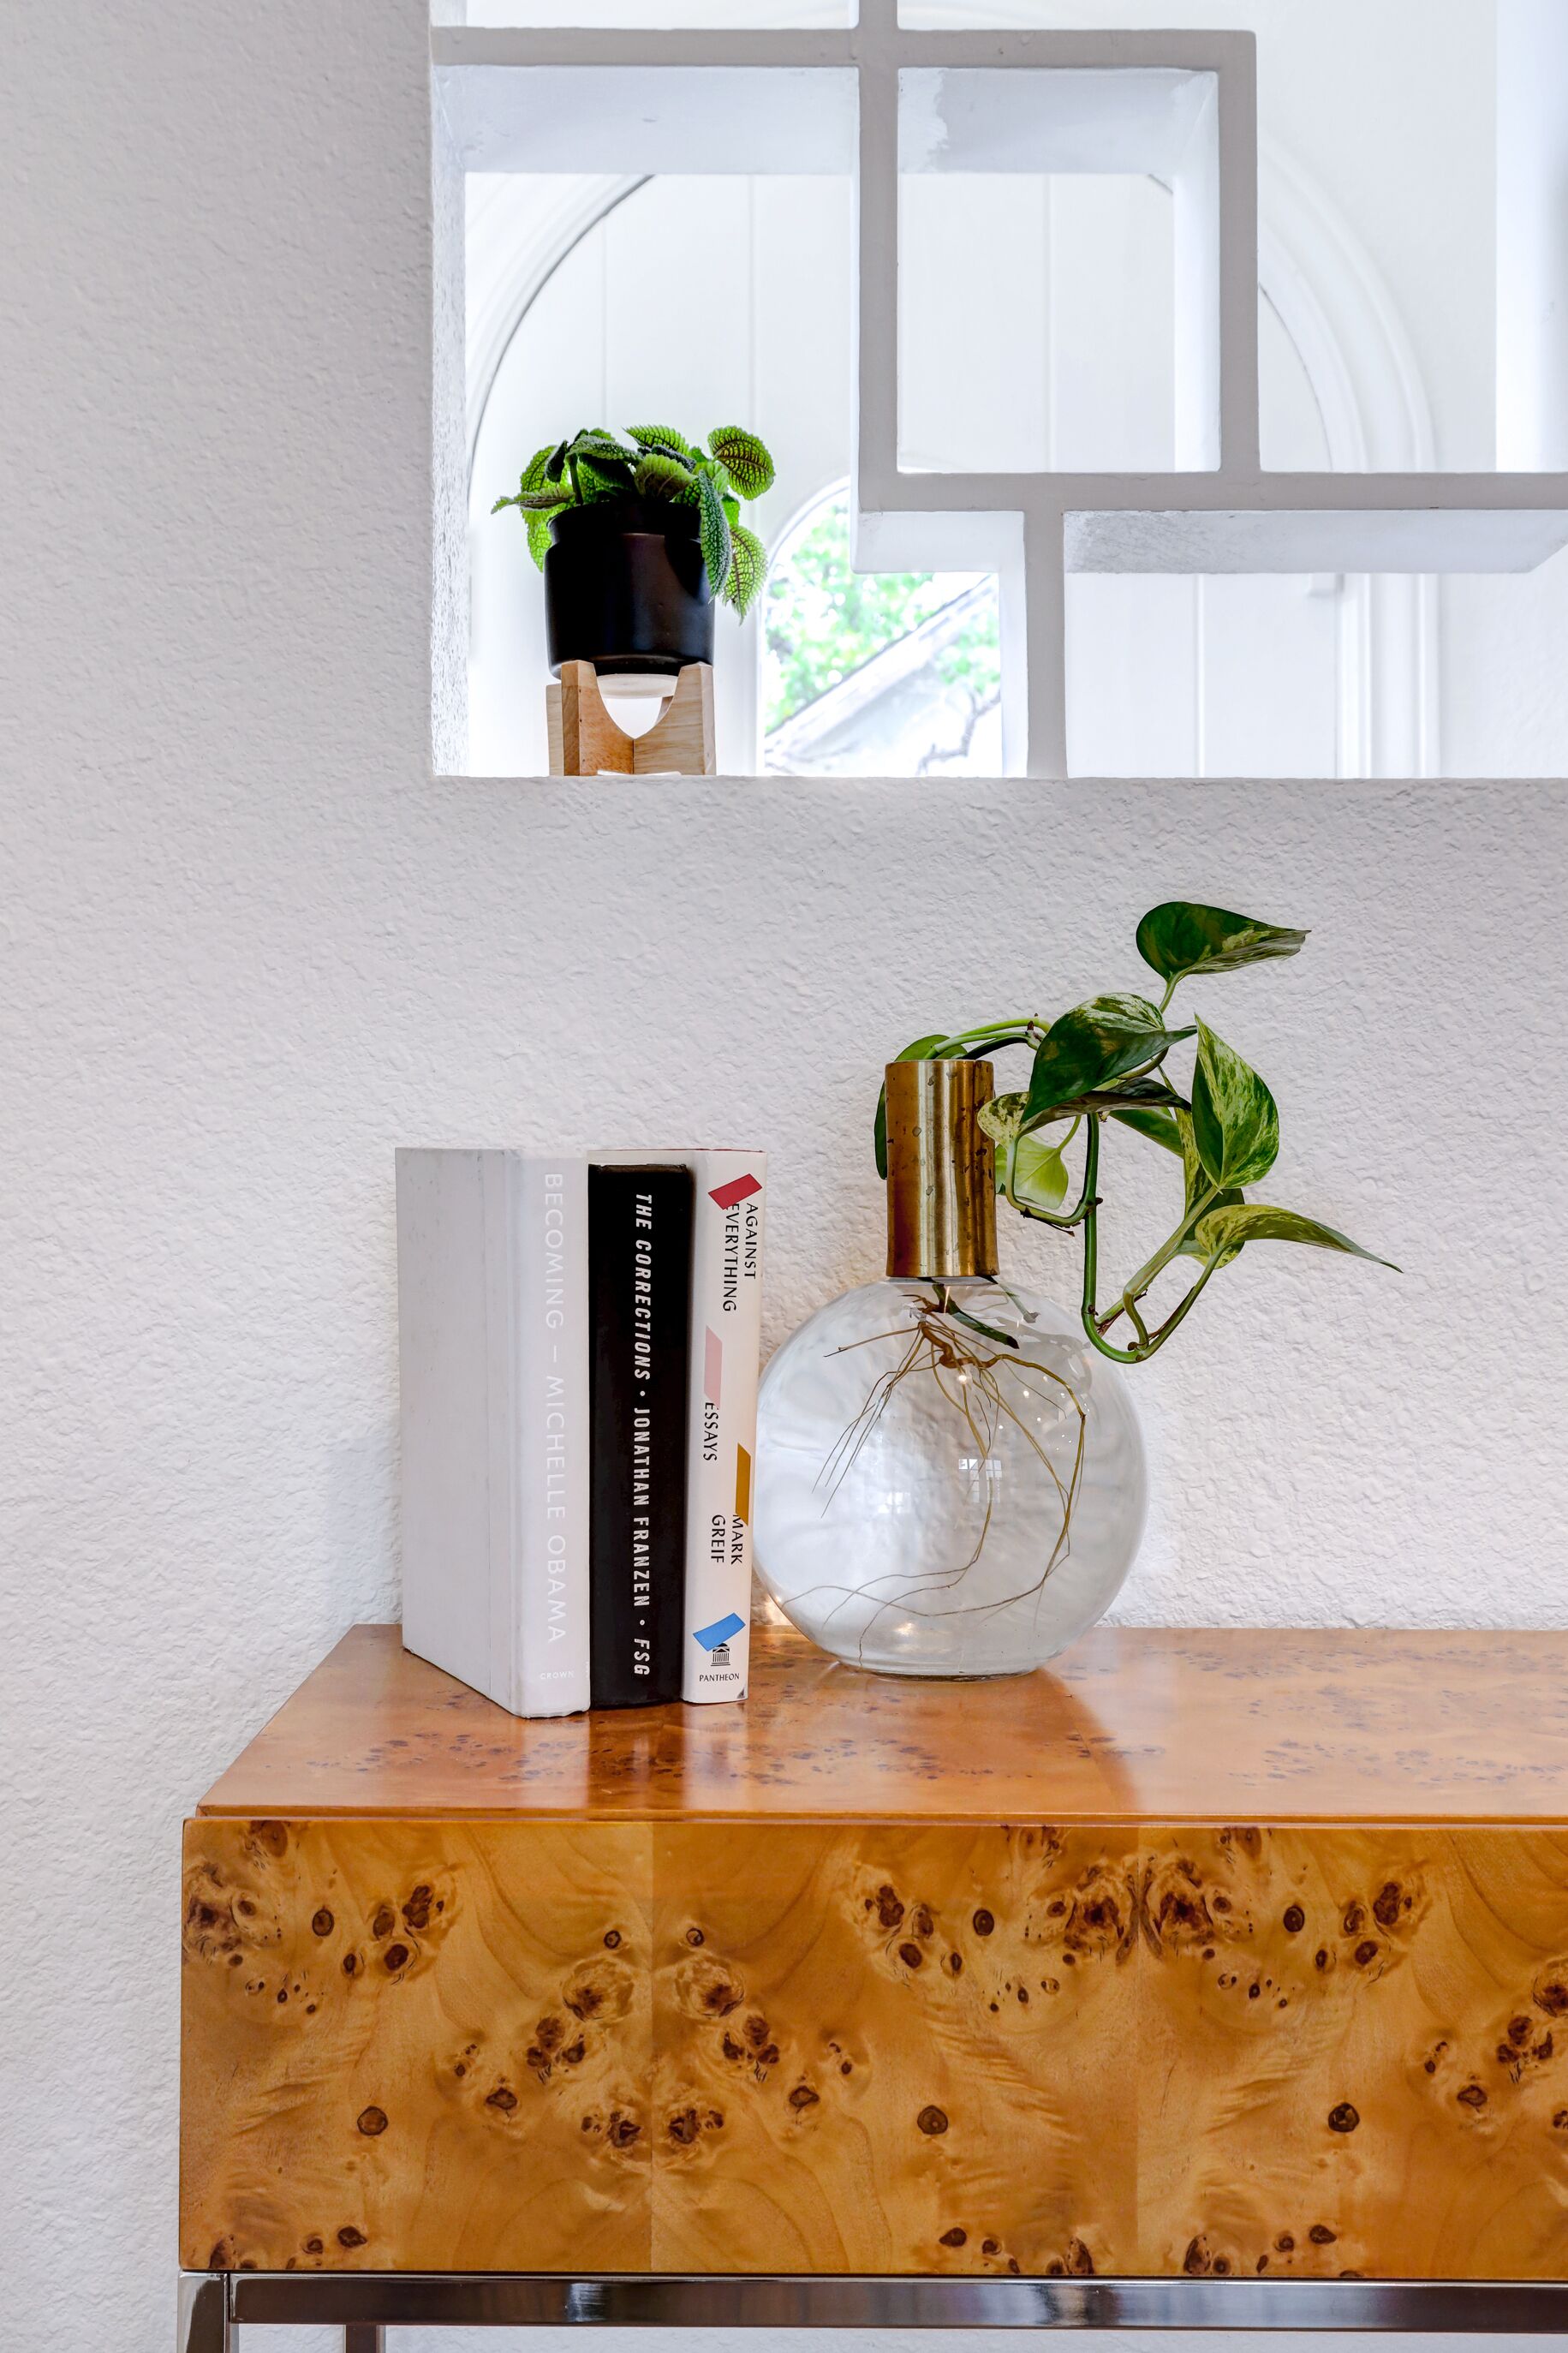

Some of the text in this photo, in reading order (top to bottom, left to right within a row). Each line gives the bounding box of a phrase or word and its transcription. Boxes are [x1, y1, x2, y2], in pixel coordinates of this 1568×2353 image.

[635, 1193, 653, 1230] THE
[743, 1202, 759, 1280] AGAINST
[545, 1173, 563, 1329] BECOMING
[634, 1239, 653, 1381] CORRECTIONS
[546, 1376, 565, 1519] MICHELLE
[633, 1407, 651, 1506] JONATHAN
[702, 1402, 719, 1461] ESSAYS
[633, 1517, 650, 1607] FRANZEN
[710, 1514, 726, 1564] GREIF
[546, 1534, 567, 1643] OBAMA
[540, 1669, 575, 1681] CROWN
[633, 1638, 650, 1675] FSG
[699, 1672, 740, 1682] PANTHEON
